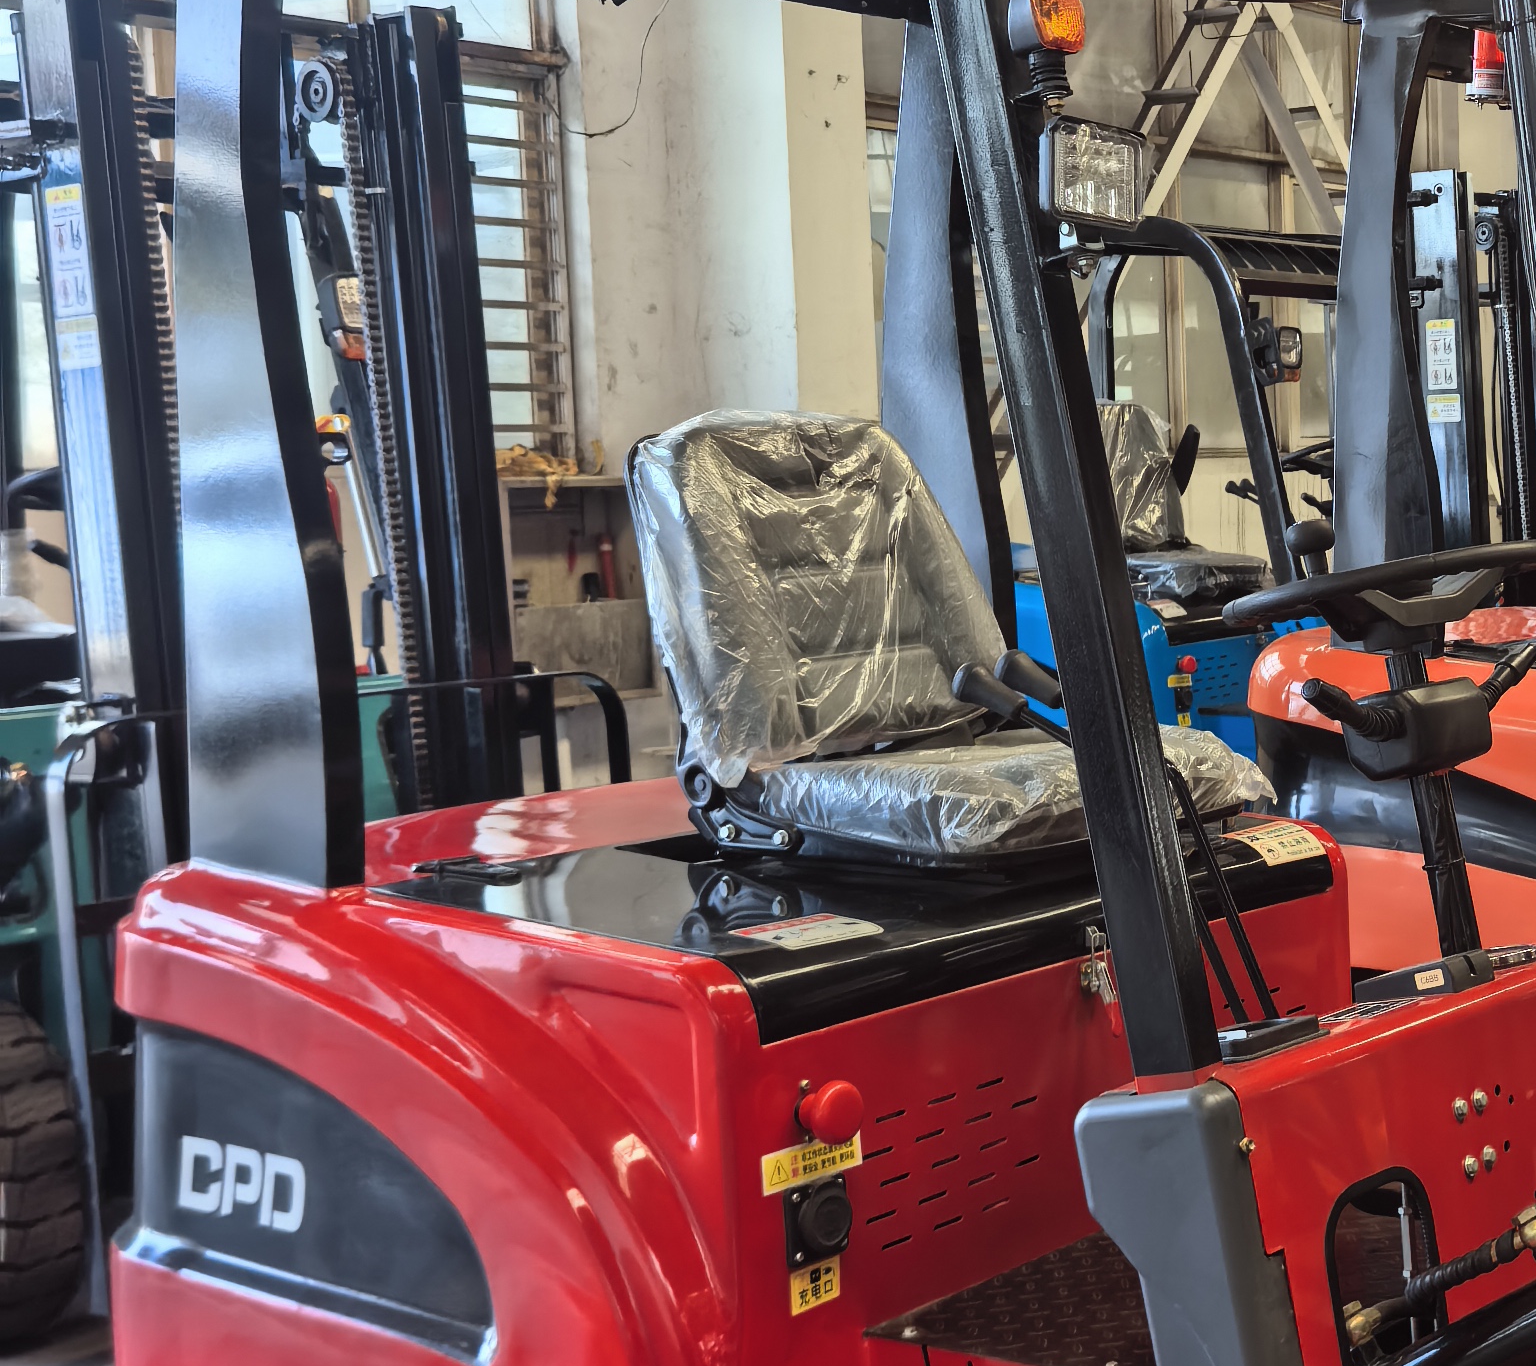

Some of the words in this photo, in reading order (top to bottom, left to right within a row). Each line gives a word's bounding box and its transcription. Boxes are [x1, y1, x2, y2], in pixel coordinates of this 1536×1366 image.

[178, 1135, 306, 1233] CPD
[799, 1279, 833, 1308] 充电口
